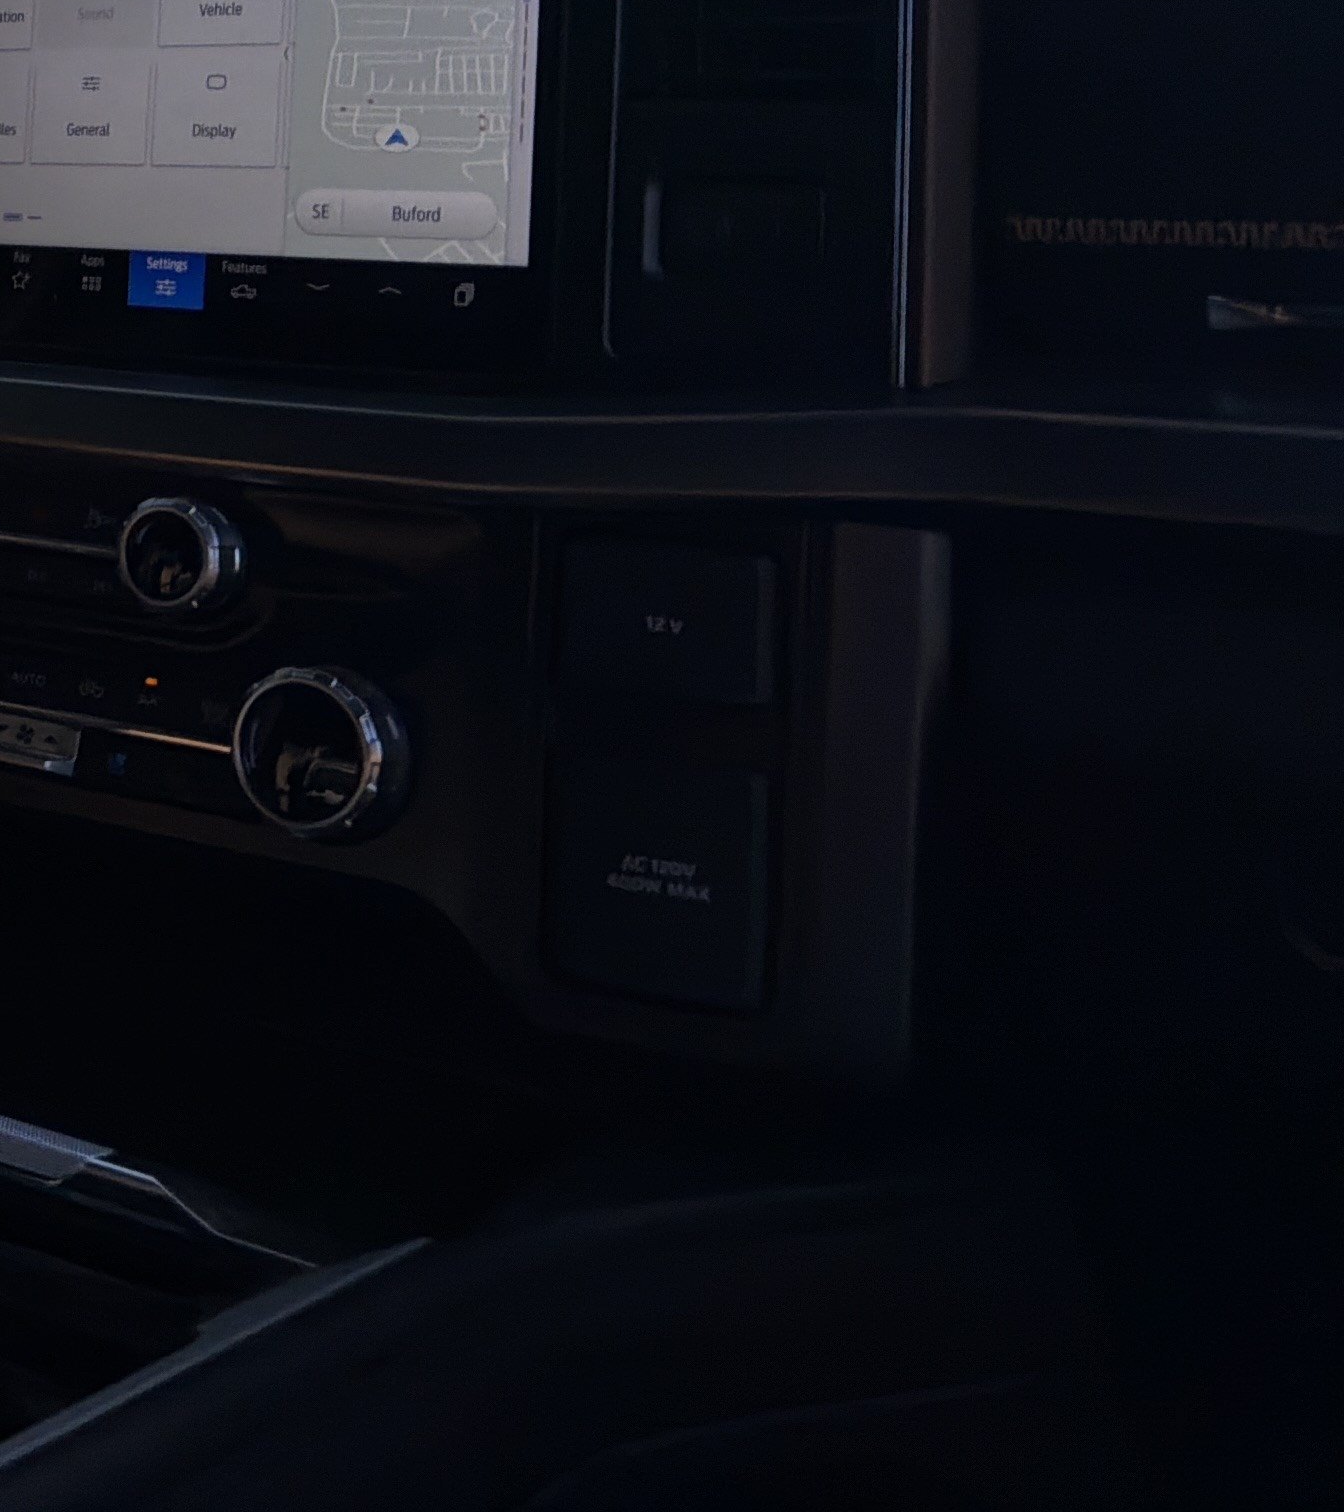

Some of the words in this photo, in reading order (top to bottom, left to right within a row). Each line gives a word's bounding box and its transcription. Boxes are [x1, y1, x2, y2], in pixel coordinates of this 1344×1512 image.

[199, 3, 242, 16] Vehicle
[66, 123, 110, 137] General
[192, 124, 236, 139] Display
[313, 203, 330, 219] SE
[392, 205, 441, 222] Buford
[146, 256, 188, 273] Settings
